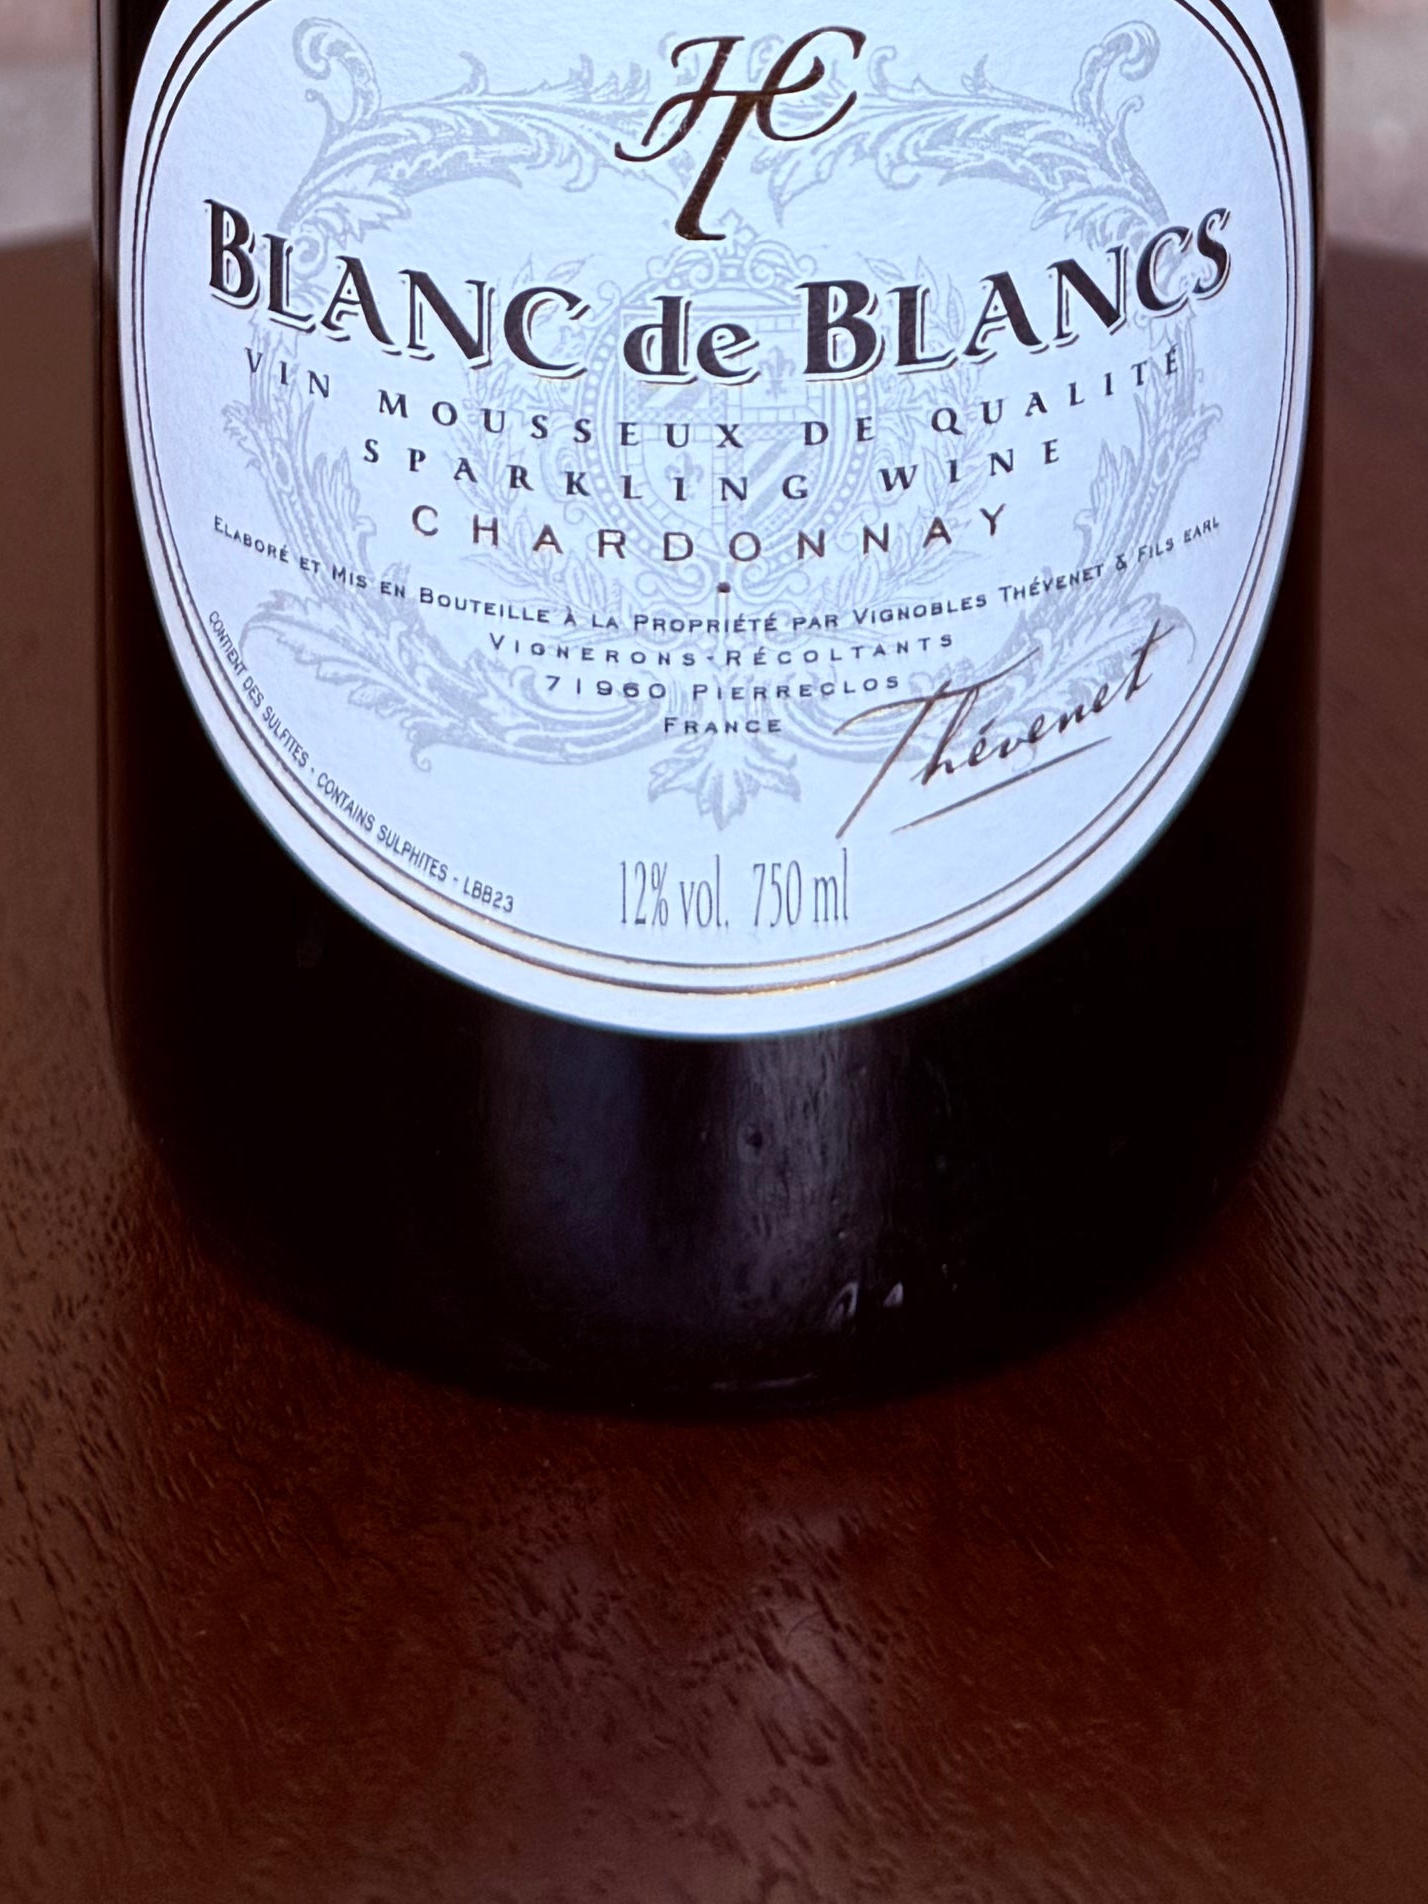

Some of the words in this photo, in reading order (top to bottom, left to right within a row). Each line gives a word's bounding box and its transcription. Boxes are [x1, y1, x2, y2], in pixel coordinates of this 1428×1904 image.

[203, 198, 591, 380] BLANC
[623, 295, 761, 385] de
[794, 207, 1232, 382] BLANCS
[244, 347, 332, 399] VIN
[378, 388, 743, 449] MOUSSEUX
[803, 416, 874, 447] DE
[930, 343, 1180, 435] QUALITÉ
[363, 438, 809, 501] SPARKLING
[878, 438, 1060, 492] WINE
[299, 556, 321, 574] ET
[379, 580, 406, 598] EN
[419, 587, 550, 624] BOUTEILLE
[563, 605, 577, 627] À
[591, 614, 619, 629] LA
[634, 612, 778, 634] PROPRIÉTÉ
[792, 614, 839, 631] PAR
[853, 593, 988, 626] VIGNOBLES
[998, 563, 1105, 603] THÉVENET
[1115, 553, 1128, 571] &
[1136, 537, 1175, 564] FILS
[1183, 515, 1221, 544] EARL
[411, 503, 1006, 563] CHARDONNAY
[545, 675, 667, 699] 71960
[692, 675, 900, 701] PIERRECLOS
[664, 717, 783, 734] FRANCE
[833, 617, 1176, 839] Thévenet
[208, 610, 248, 676] CONTIENT
[242, 676, 265, 708] DES
[262, 705, 310, 767] SULFITES
[316, 772, 376, 832] CONTAINS
[376, 824, 449, 882] SULPHITES
[463, 876, 515, 913] LBB23
[619, 859, 669, 927] 12%
[680, 853, 729, 928] vol.
[752, 859, 802, 928] 750
[813, 847, 849, 924] ml
